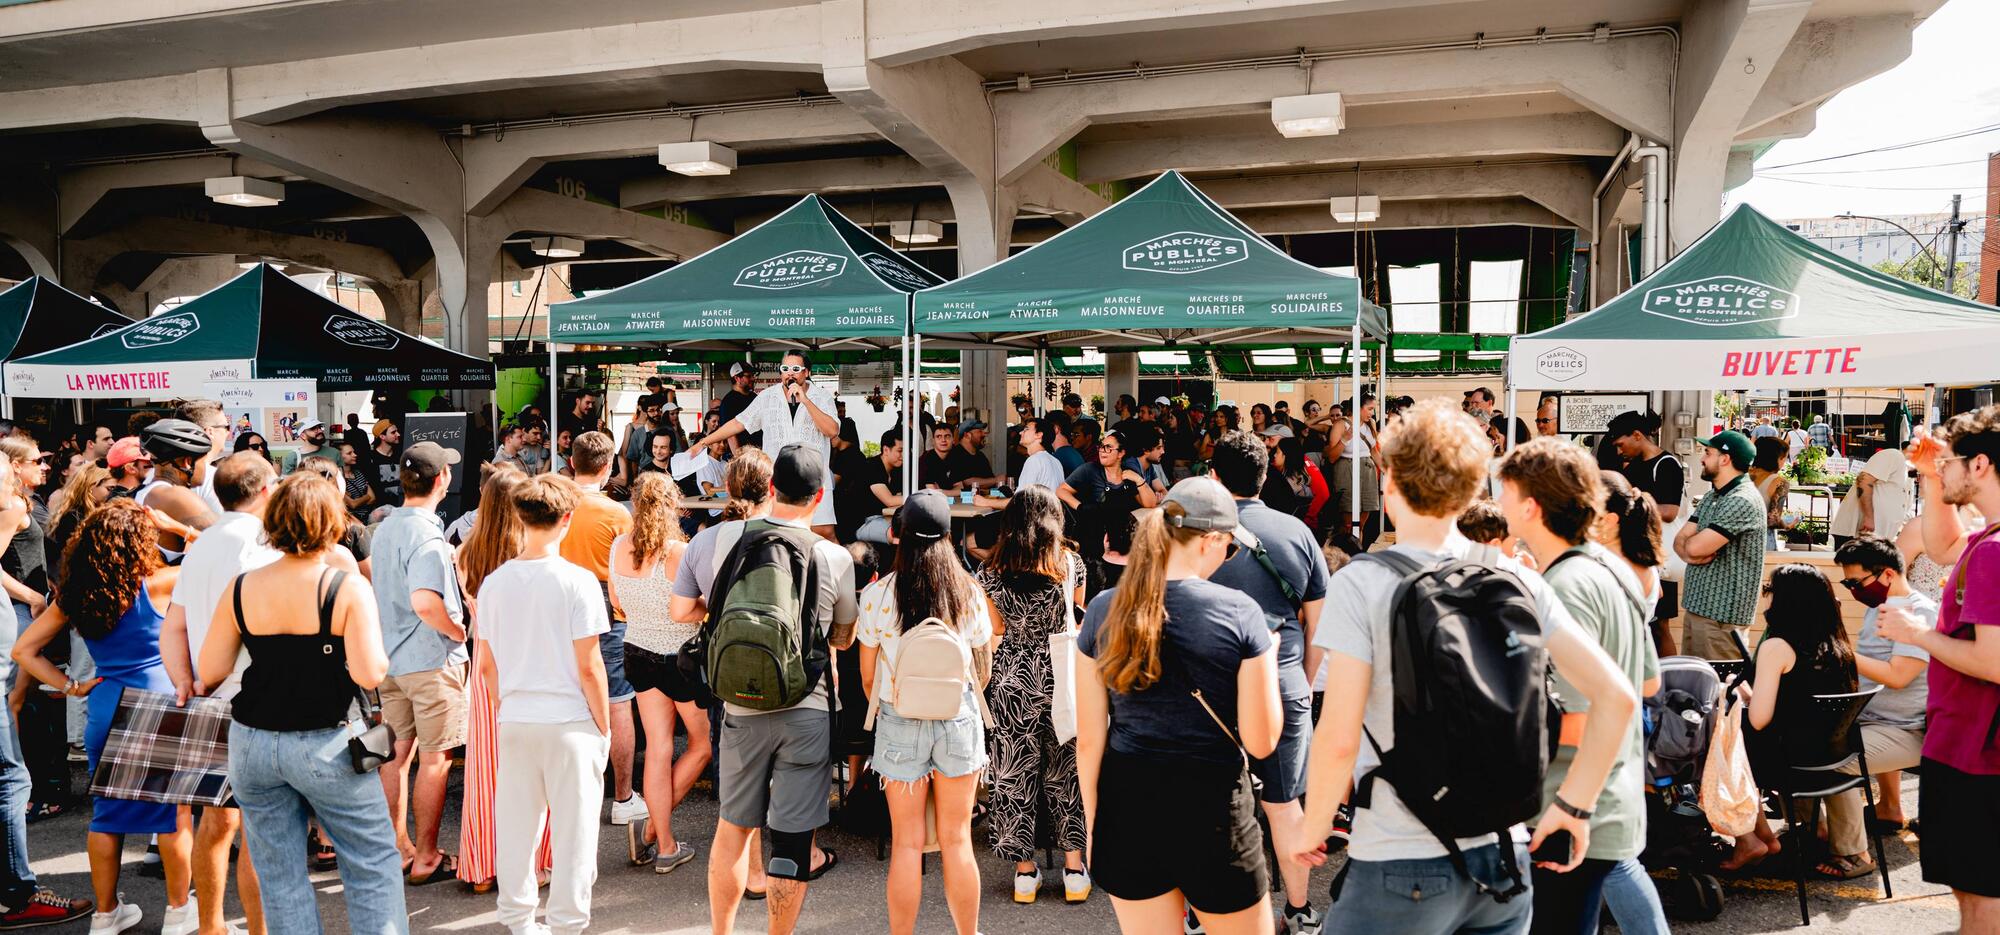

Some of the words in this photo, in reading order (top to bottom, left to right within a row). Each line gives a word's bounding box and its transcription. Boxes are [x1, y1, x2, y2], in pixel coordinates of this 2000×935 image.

[555, 176, 586, 200] 106
[664, 203, 688, 224] 051
[1146, 238, 1222, 250] MARCHÉS
[1132, 246, 1238, 262] PUBLICS
[762, 255, 829, 270] MARCHÉS
[1168, 257, 1218, 265] MONTRÉAL
[744, 262, 838, 280] PUBLICS
[772, 274, 815, 282] MONTRÉAL
[1286, 292, 1328, 300] MARCHÉS
[1675, 284, 1770, 298] MARCHÉS
[1017, 299, 1053, 307] MARCHÉ
[1104, 295, 1141, 304] MARCHÉ
[1189, 295, 1228, 303] MARCHÉS
[1654, 295, 1787, 310] PUBLICS
[702, 308, 732, 316] MARCHÉ
[1081, 305, 1165, 316] MAISONNEUVE
[1271, 302, 1343, 314] SOLIDAIRES
[631, 311, 660, 319] MARCHÉ
[926, 311, 989, 320] JEAN-TALON
[1009, 309, 1059, 319] ATWATER
[625, 320, 665, 329] ATWATER
[683, 318, 750, 328] MAISONNEUVE
[836, 315, 895, 325] SOLIDAIRES
[134, 325, 188, 338] PUBLICS
[558, 322, 610, 331] JEAN-TALON
[335, 328, 387, 339] PUBLICS
[1540, 360, 1583, 368] PUBLICS
[1721, 347, 1861, 377] BUVETTE
[67, 374, 84, 391] LA
[87, 371, 170, 391] PIMENTERIE
[322, 375, 353, 383] ATWATER
[365, 374, 411, 382] MAISONNEUVE
[420, 374, 449, 382] QUARTIER
